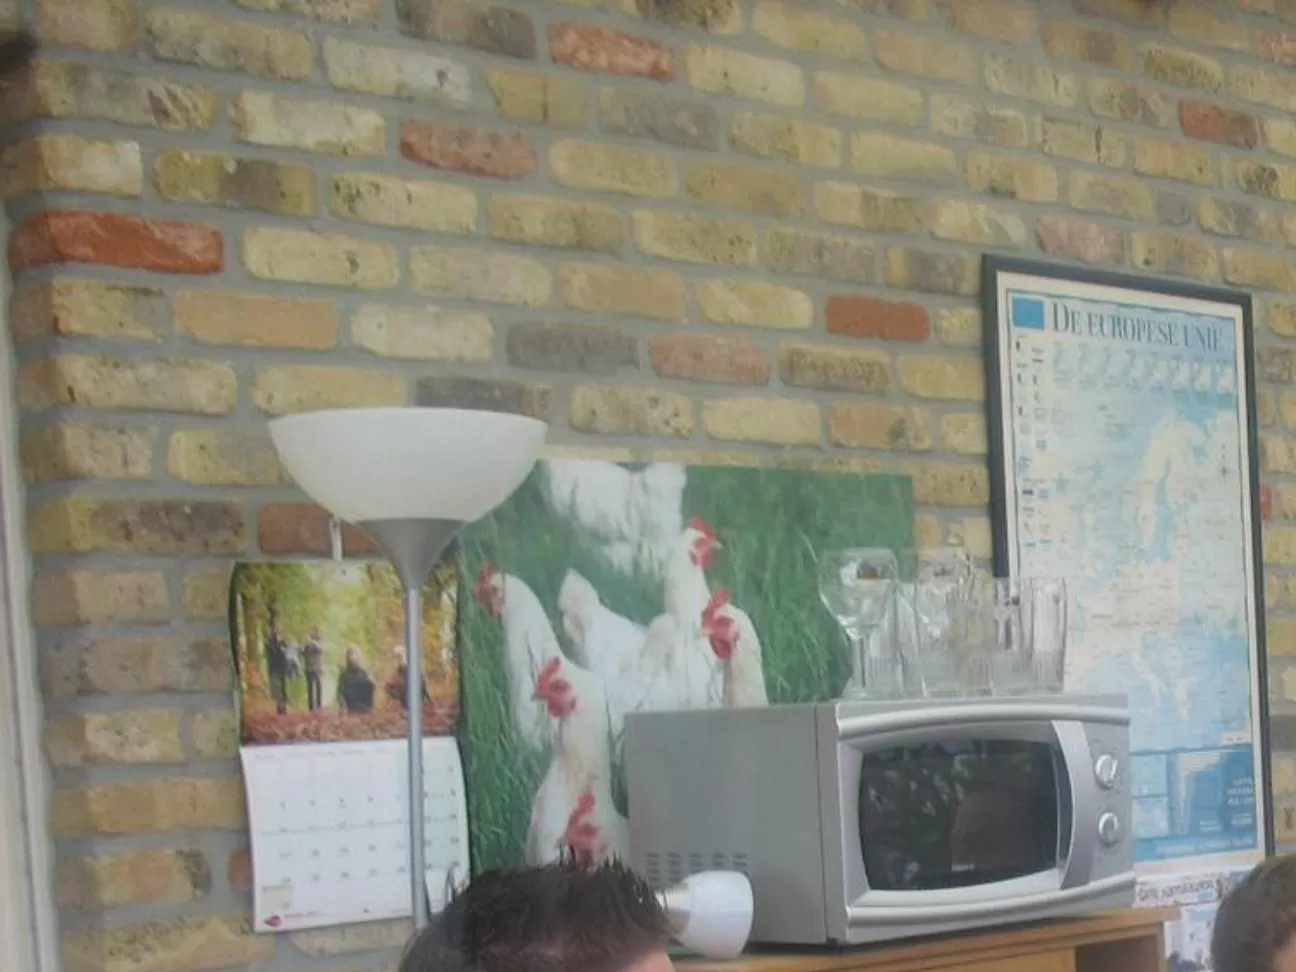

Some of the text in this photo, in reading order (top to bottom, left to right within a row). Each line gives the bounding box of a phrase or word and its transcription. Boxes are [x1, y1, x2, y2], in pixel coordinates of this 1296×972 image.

[1052, 302, 1224, 352] DE EUROPESE UNIE
